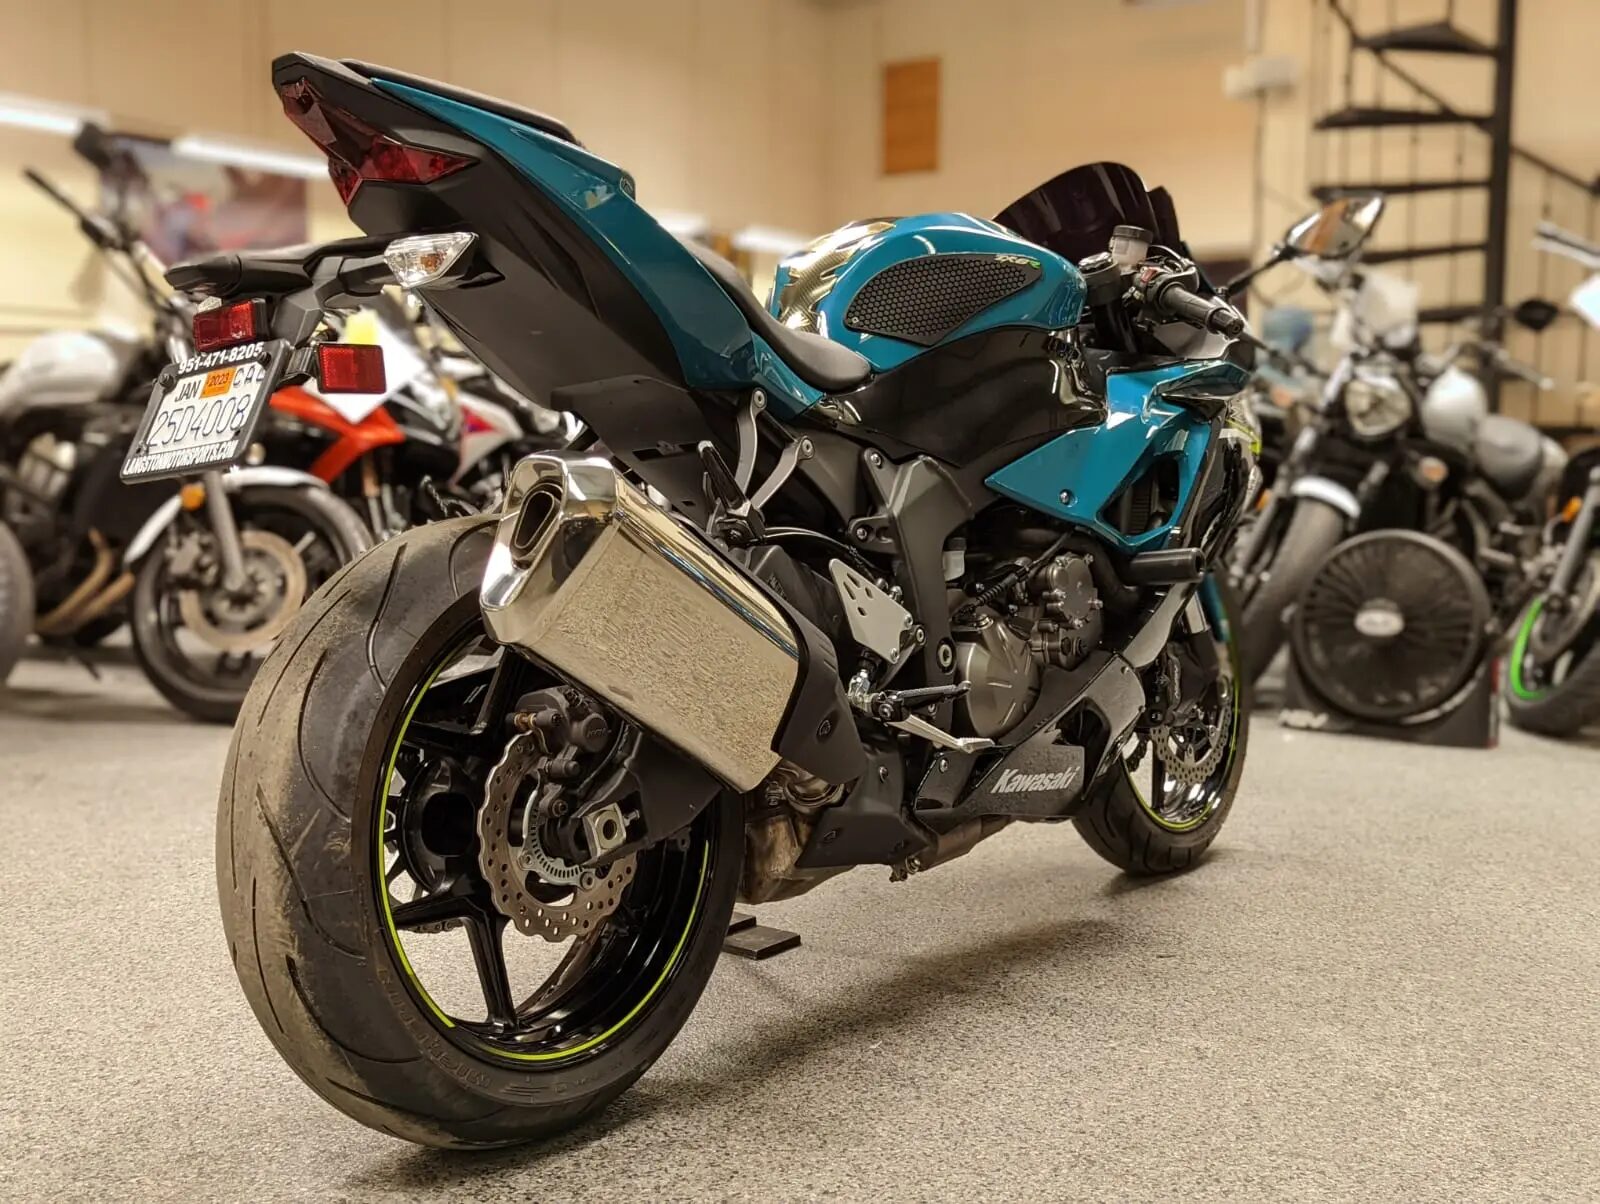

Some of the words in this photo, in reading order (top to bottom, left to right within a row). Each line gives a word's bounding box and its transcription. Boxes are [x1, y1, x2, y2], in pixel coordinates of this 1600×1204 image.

[177, 342, 264, 375] 951-471-8205
[175, 380, 202, 402] JAN
[208, 373, 230, 387] 2023
[146, 394, 251, 448] 25D4008
[122, 439, 239, 476] LANGSTONMOTORSPORTS.COM
[990, 766, 1080, 794] Kawasaki
